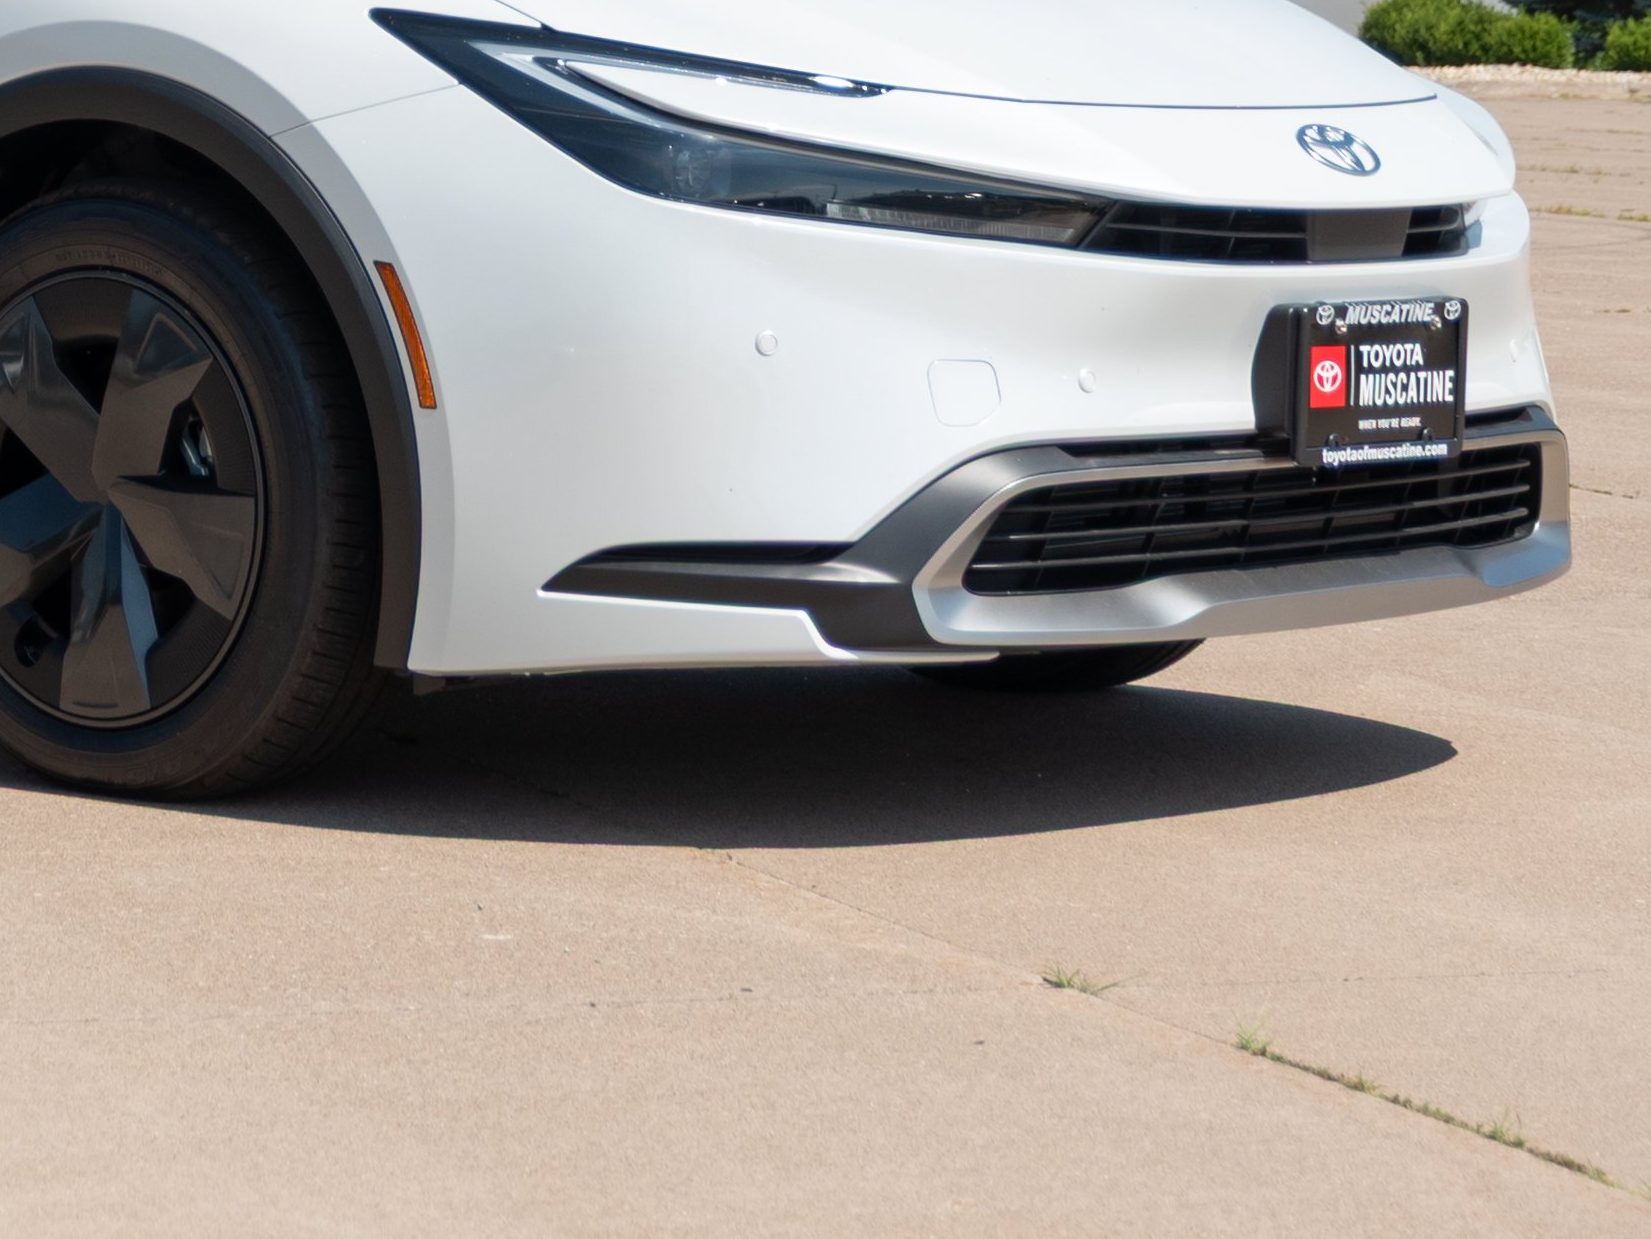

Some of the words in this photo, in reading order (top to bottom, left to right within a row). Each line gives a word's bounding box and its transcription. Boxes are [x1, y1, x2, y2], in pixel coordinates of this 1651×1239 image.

[1345, 302, 1435, 325] MUSCATINE
[1359, 343, 1424, 368] TOYOTA
[1359, 370, 1455, 407] MUSCATINE
[1322, 443, 1448, 466] toyotaofmuscatine.com
